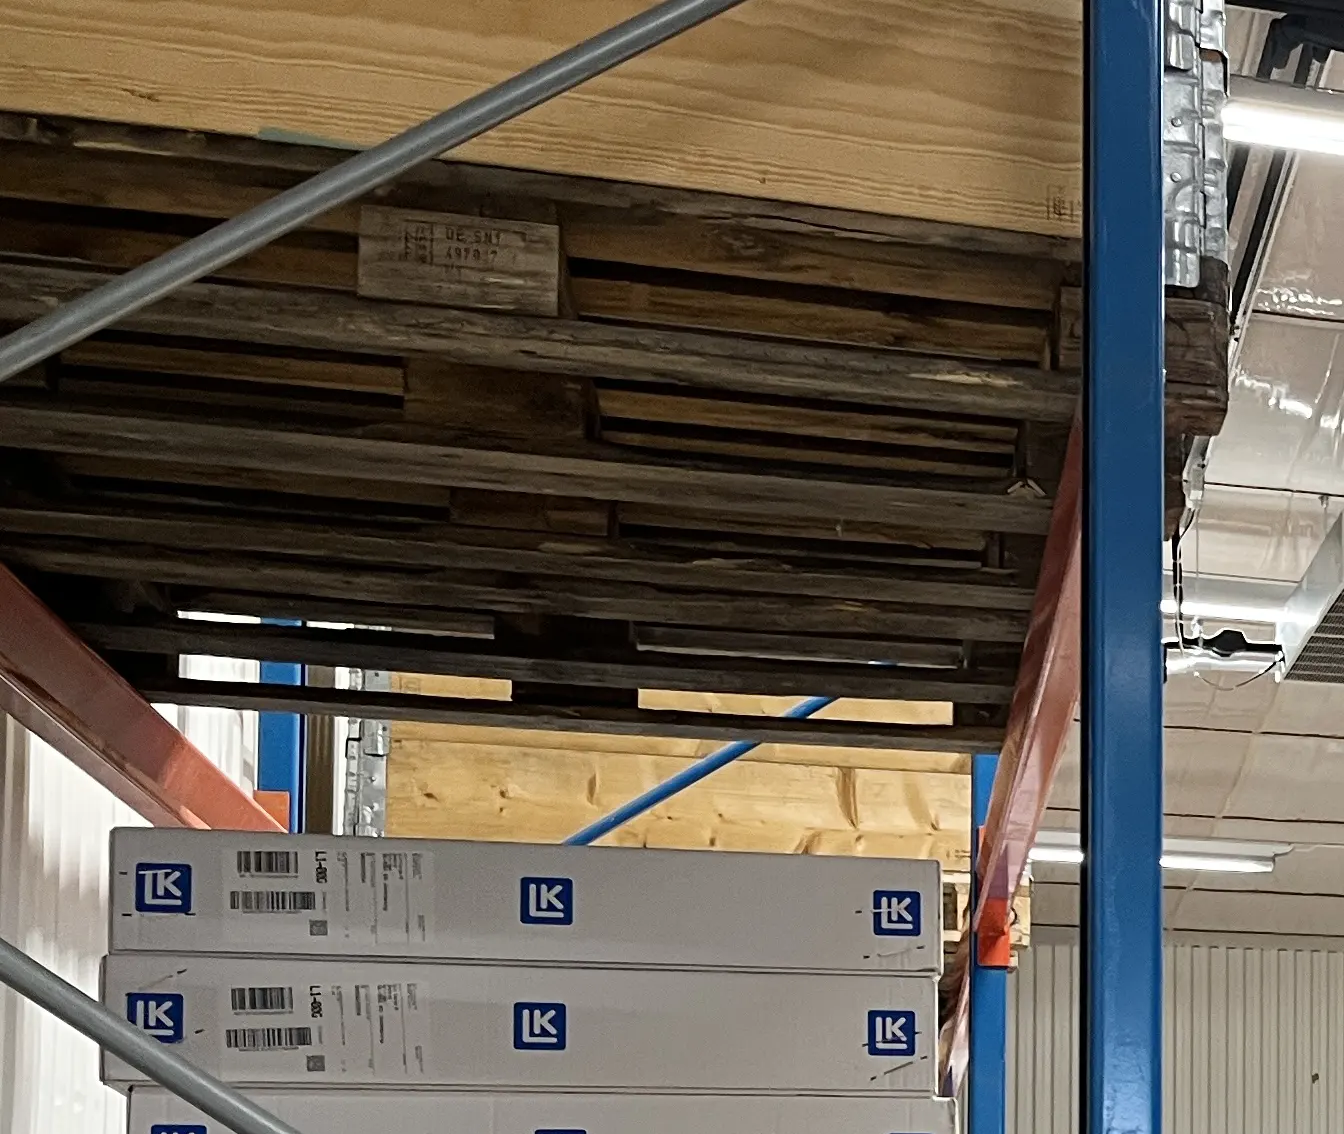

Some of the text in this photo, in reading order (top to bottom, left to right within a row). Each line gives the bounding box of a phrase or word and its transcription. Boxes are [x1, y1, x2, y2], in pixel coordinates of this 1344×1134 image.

[529, 884, 565, 918] LK
[881, 897, 914, 929] LK
[522, 1009, 557, 1043] LK
[876, 1017, 908, 1050] LK
